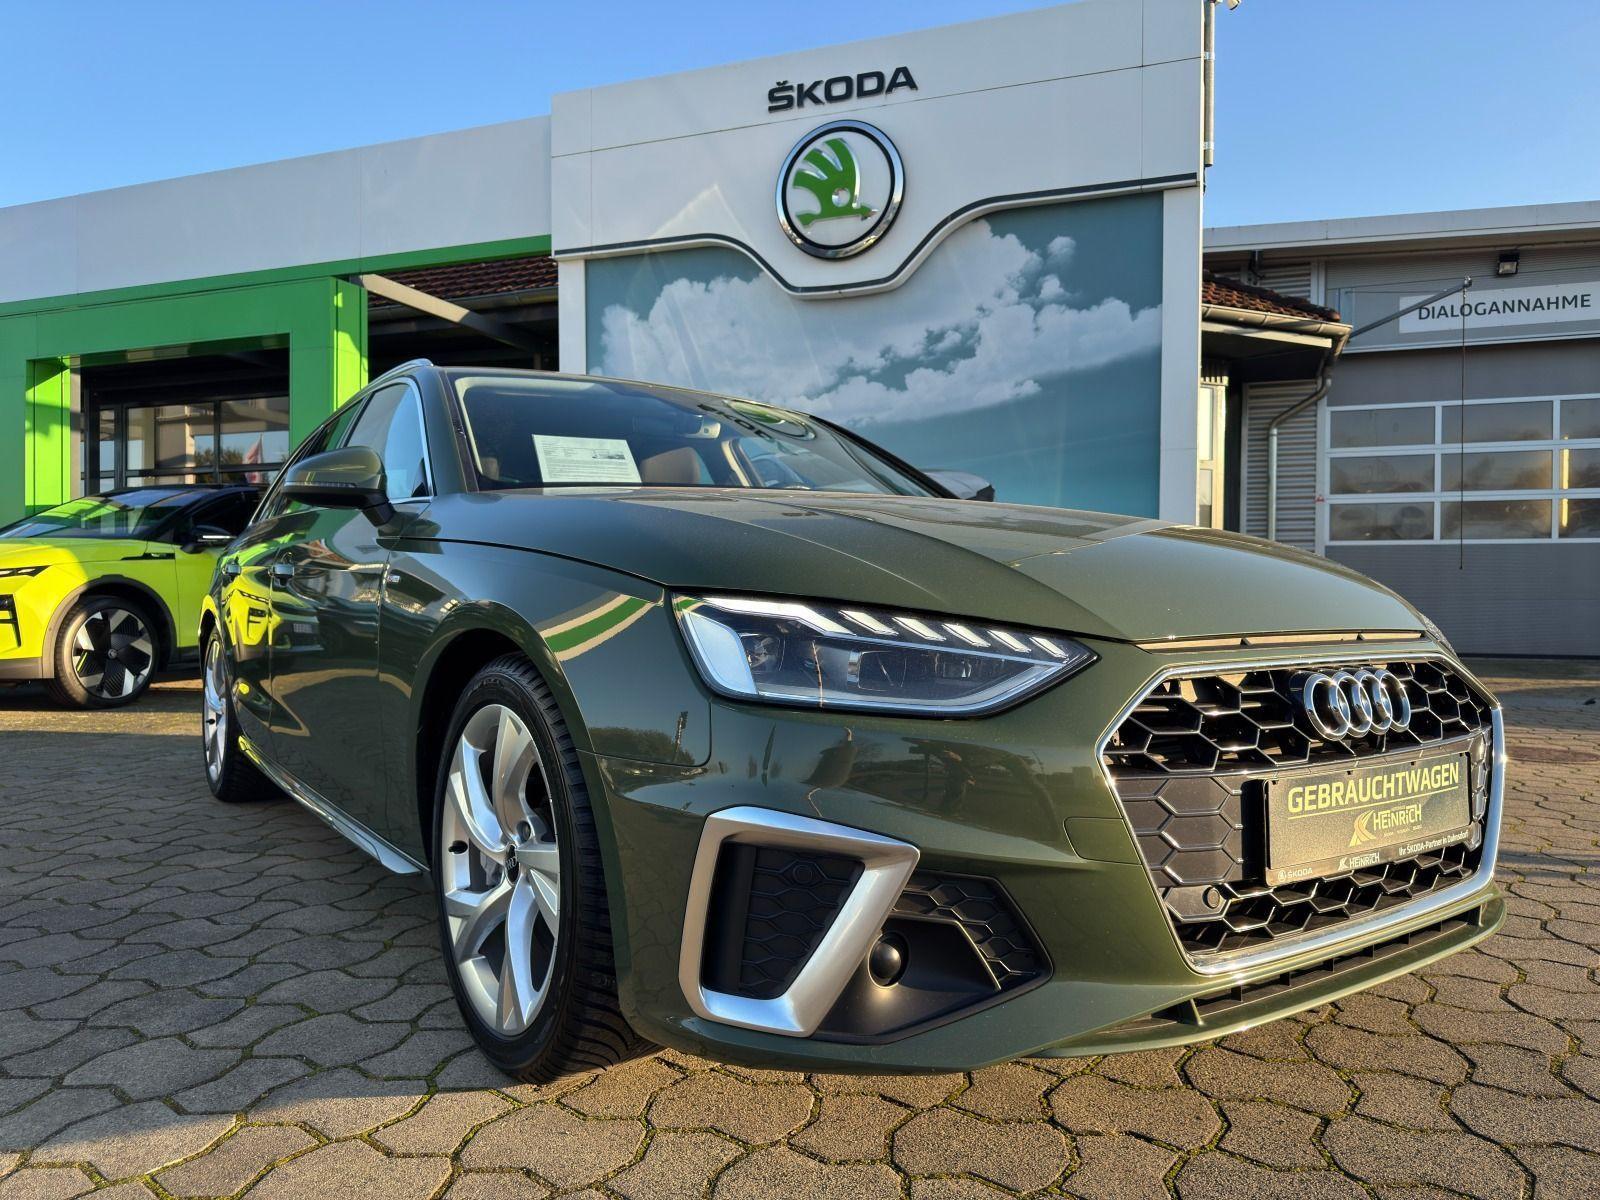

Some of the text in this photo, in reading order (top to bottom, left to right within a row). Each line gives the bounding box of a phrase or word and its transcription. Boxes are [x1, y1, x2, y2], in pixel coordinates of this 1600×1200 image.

[768, 66, 918, 113] ŠKODA
[1418, 294, 1591, 321] DIALOGANNAHME
[1287, 762, 1459, 813] GEBRAUCHTWAGEN
